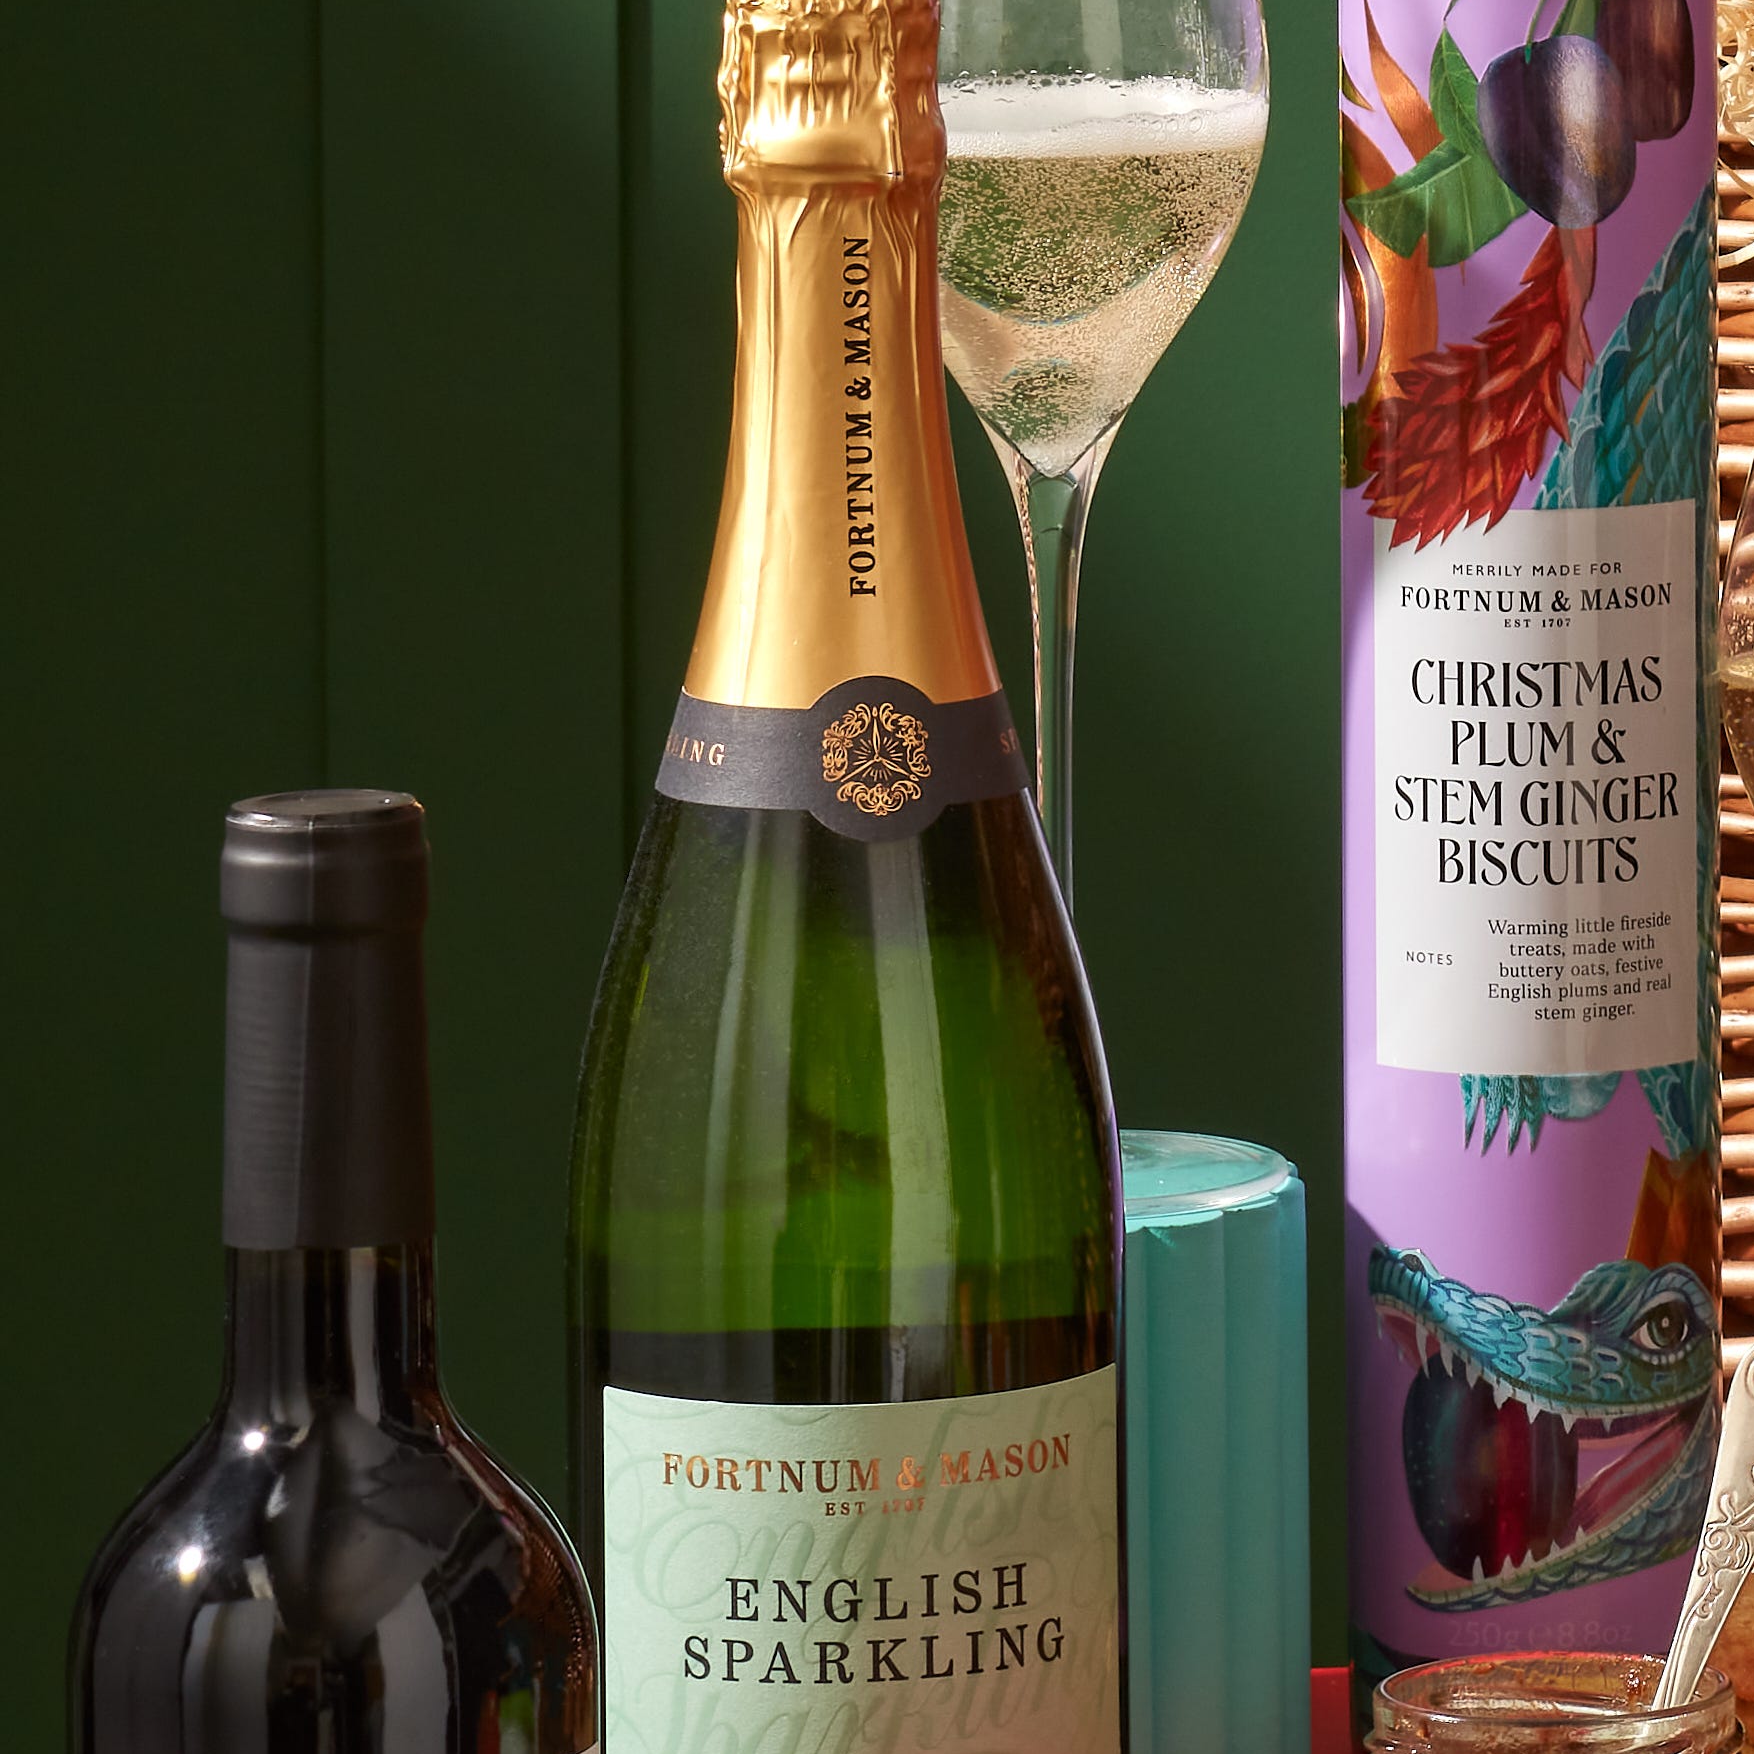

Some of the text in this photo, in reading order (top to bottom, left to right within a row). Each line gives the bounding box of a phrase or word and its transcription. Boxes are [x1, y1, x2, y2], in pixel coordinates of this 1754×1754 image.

[842, 236, 878, 598] FORTNUM & MASON
[1401, 581, 1672, 613] FORTNUM & MASON
[1411, 655, 1663, 709] CHRISTMAS
[1450, 718, 1627, 768] PLUM &
[1394, 771, 1679, 827] STEM GINGER
[1438, 835, 1639, 887] BISCUITS
[1487, 910, 1672, 939] Warming little fireside
[1406, 950, 1453, 966] NOTES
[1534, 1002, 1636, 1023] stem ginger.
[662, 1433, 1072, 1494] FORTNUM & MASON
[724, 1562, 1028, 1624] ENGLISH
[684, 1616, 1065, 1685] SPARKLING
